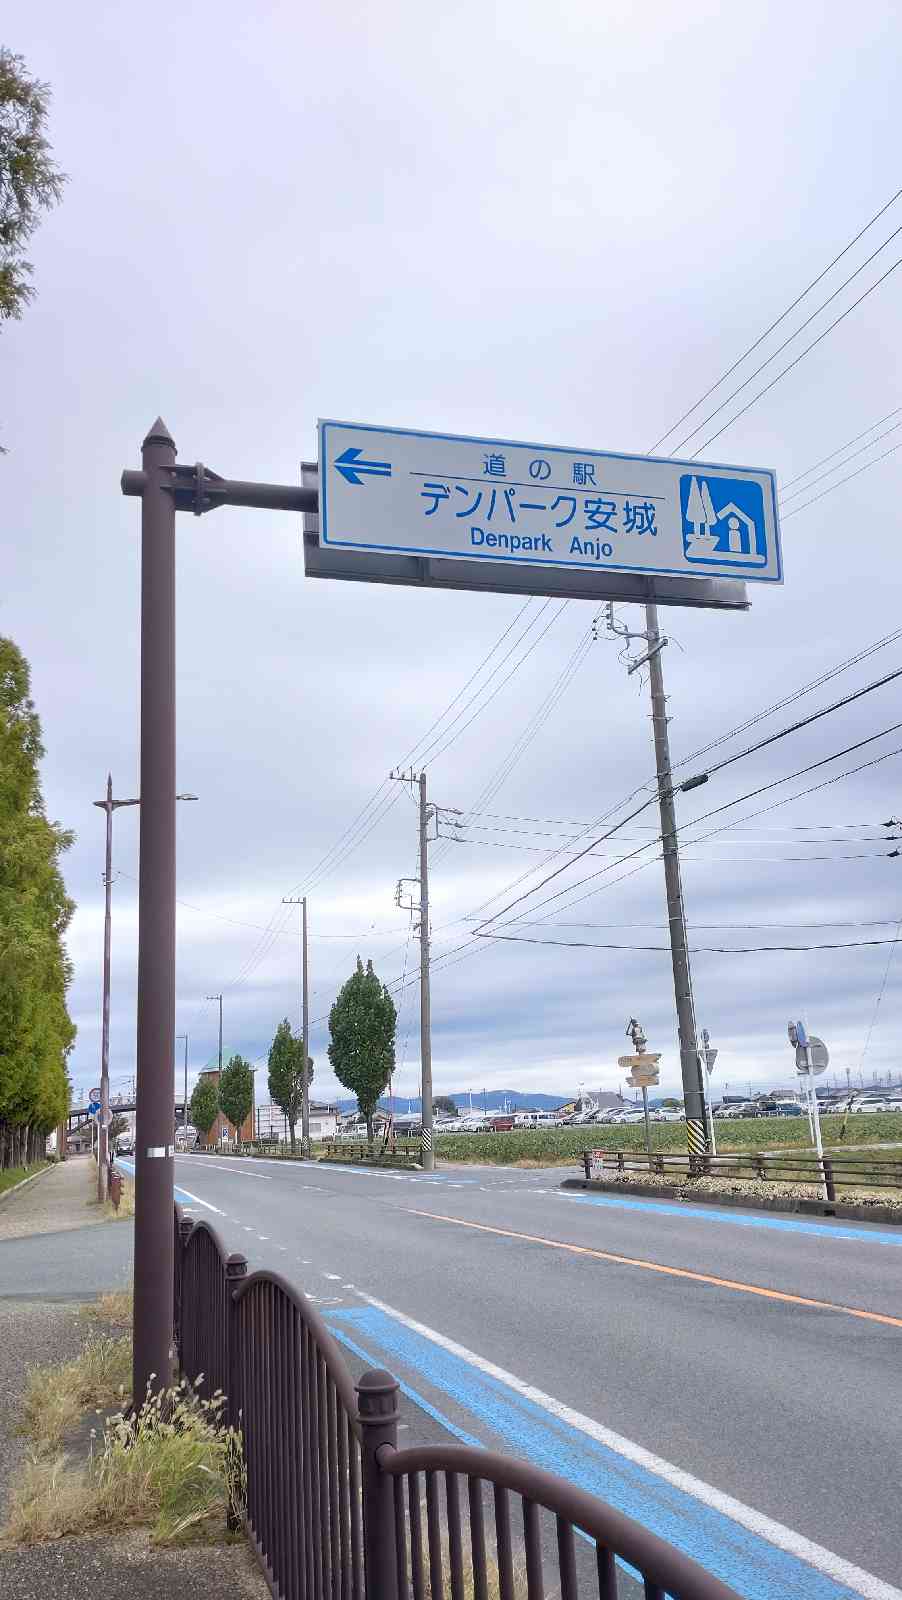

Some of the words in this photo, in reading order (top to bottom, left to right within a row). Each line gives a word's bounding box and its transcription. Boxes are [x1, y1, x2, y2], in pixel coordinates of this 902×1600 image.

[483, 454, 597, 486] 道の駅
[421, 482, 657, 536] デンパーク安城
[471, 527, 552, 553] Denpark
[570, 536, 613, 560] Anjo
